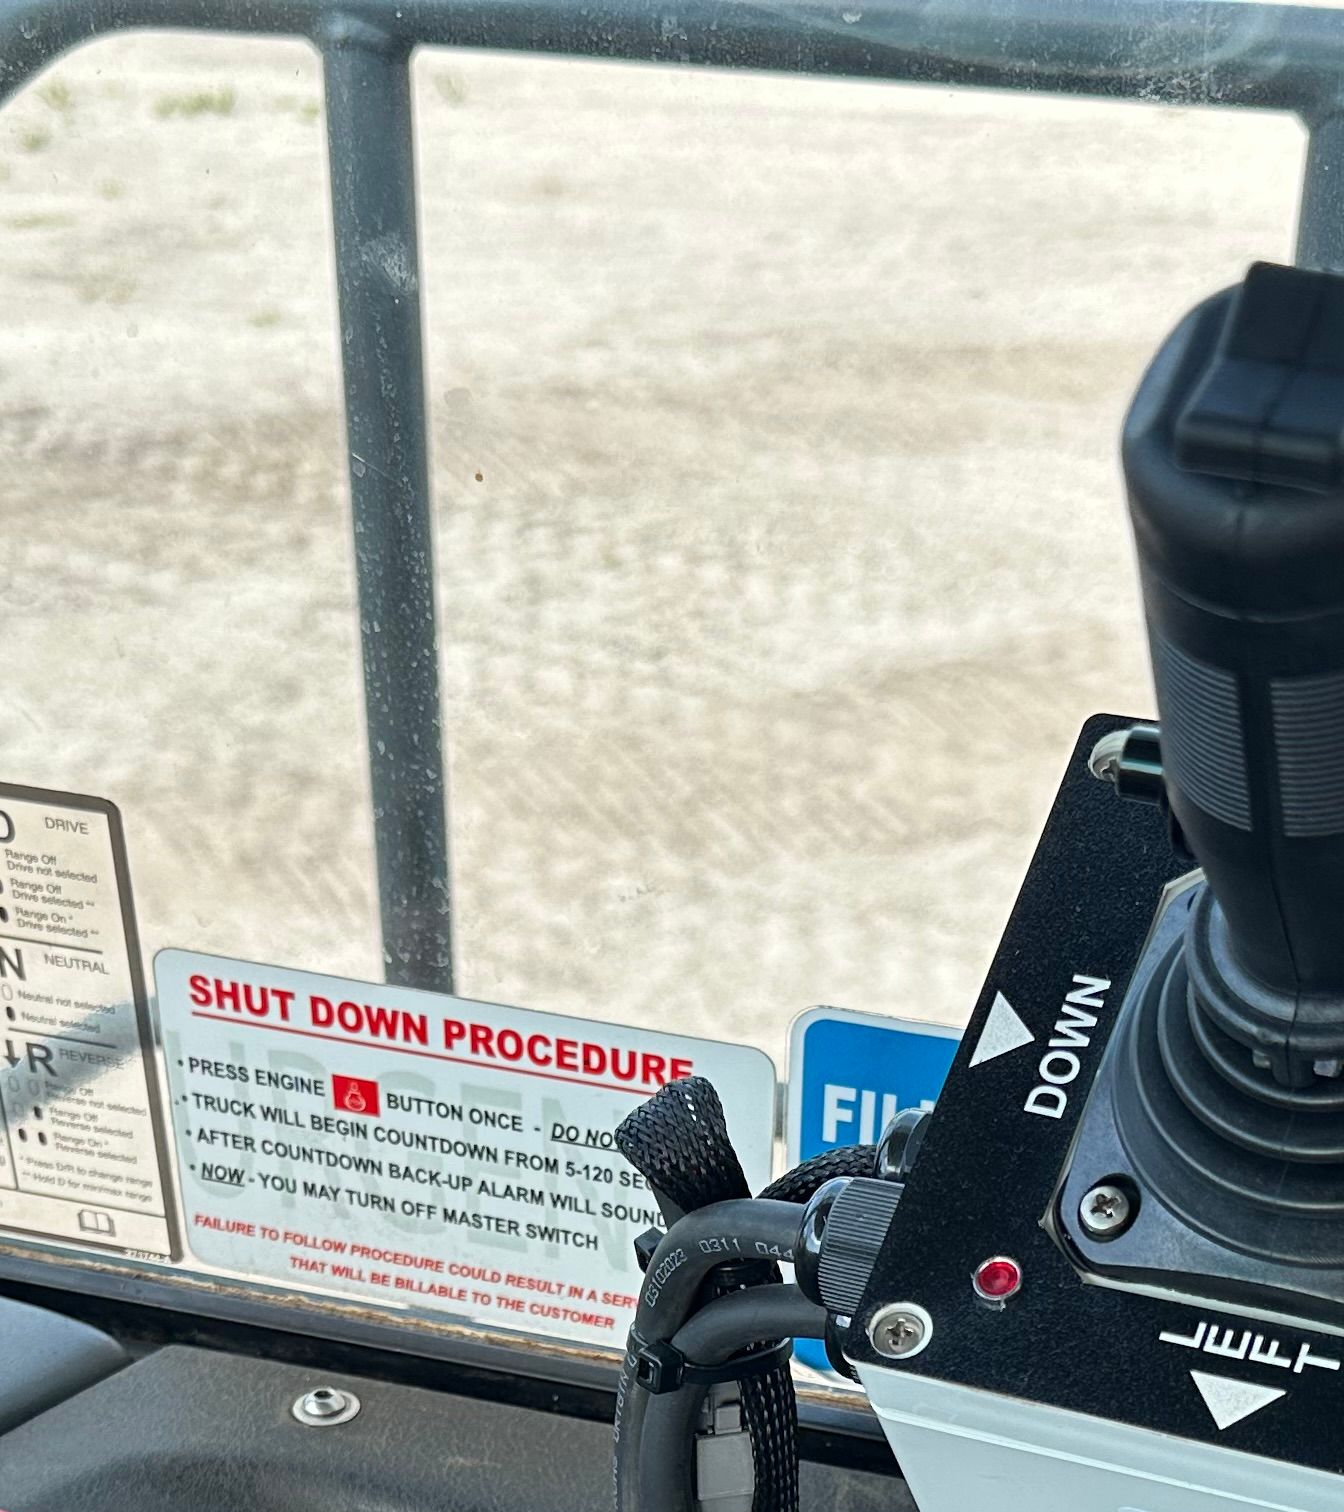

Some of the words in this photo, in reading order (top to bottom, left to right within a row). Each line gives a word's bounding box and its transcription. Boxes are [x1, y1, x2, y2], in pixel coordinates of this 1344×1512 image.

[44, 816, 90, 836] DRIVE
[44, 953, 110, 975] NEUTRAL
[26, 1041, 58, 1077] R
[189, 974, 295, 1022] SHUT
[309, 995, 429, 1046] DOWN
[443, 1018, 693, 1087] PROCEDURE
[1022, 971, 1113, 1120] DOWN
[188, 1056, 250, 1083] PRESS
[255, 1069, 326, 1097] ENGINE
[386, 1093, 463, 1122] BUTTON
[469, 1108, 523, 1132] ONCE
[552, 1122, 579, 1142] DO
[192, 1093, 257, 1119] TRUCK
[259, 1105, 305, 1128] WILL
[310, 1113, 368, 1140] BEGIN
[373, 1126, 498, 1163] COUNTDOWN
[504, 1151, 559, 1174] FROM
[565, 1163, 613, 1184] 5-120
[197, 1127, 256, 1152] AFTER
[261, 1139, 383, 1177] COUNTDOWN
[388, 1162, 473, 1192] BACK-UP
[477, 1180, 544, 1206] ALARM
[549, 1192, 596, 1216] WILL
[201, 1162, 245, 1186] NOW
[258, 1172, 296, 1194] YOU
[303, 1181, 341, 1202] MAY
[345, 1189, 396, 1213] TURN
[400, 1199, 437, 1220] OFF
[443, 1207, 520, 1236] MASTER
[525, 1223, 598, 1250] SWITCH
[193, 1214, 256, 1237] FAILURE
[259, 1227, 279, 1241] TO
[282, 1231, 347, 1254] FOLLOW
[350, 1244, 444, 1274] PROCEDURE
[448, 1264, 501, 1284] COULD
[506, 1274, 564, 1298] RESULT
[568, 1286, 584, 1300] IN
[586, 1289, 599, 1303] A
[698, 1237, 741, 1253] 0311
[290, 1256, 328, 1274] THAT
[331, 1264, 366, 1283] WILL
[370, 1272, 391, 1287] BE
[395, 1277, 467, 1302] BILLABLE
[471, 1290, 492, 1306] TO
[496, 1296, 524, 1312] THE
[528, 1303, 615, 1329] CUSTOMER
[1159, 1320, 1342, 1375] LEFT
